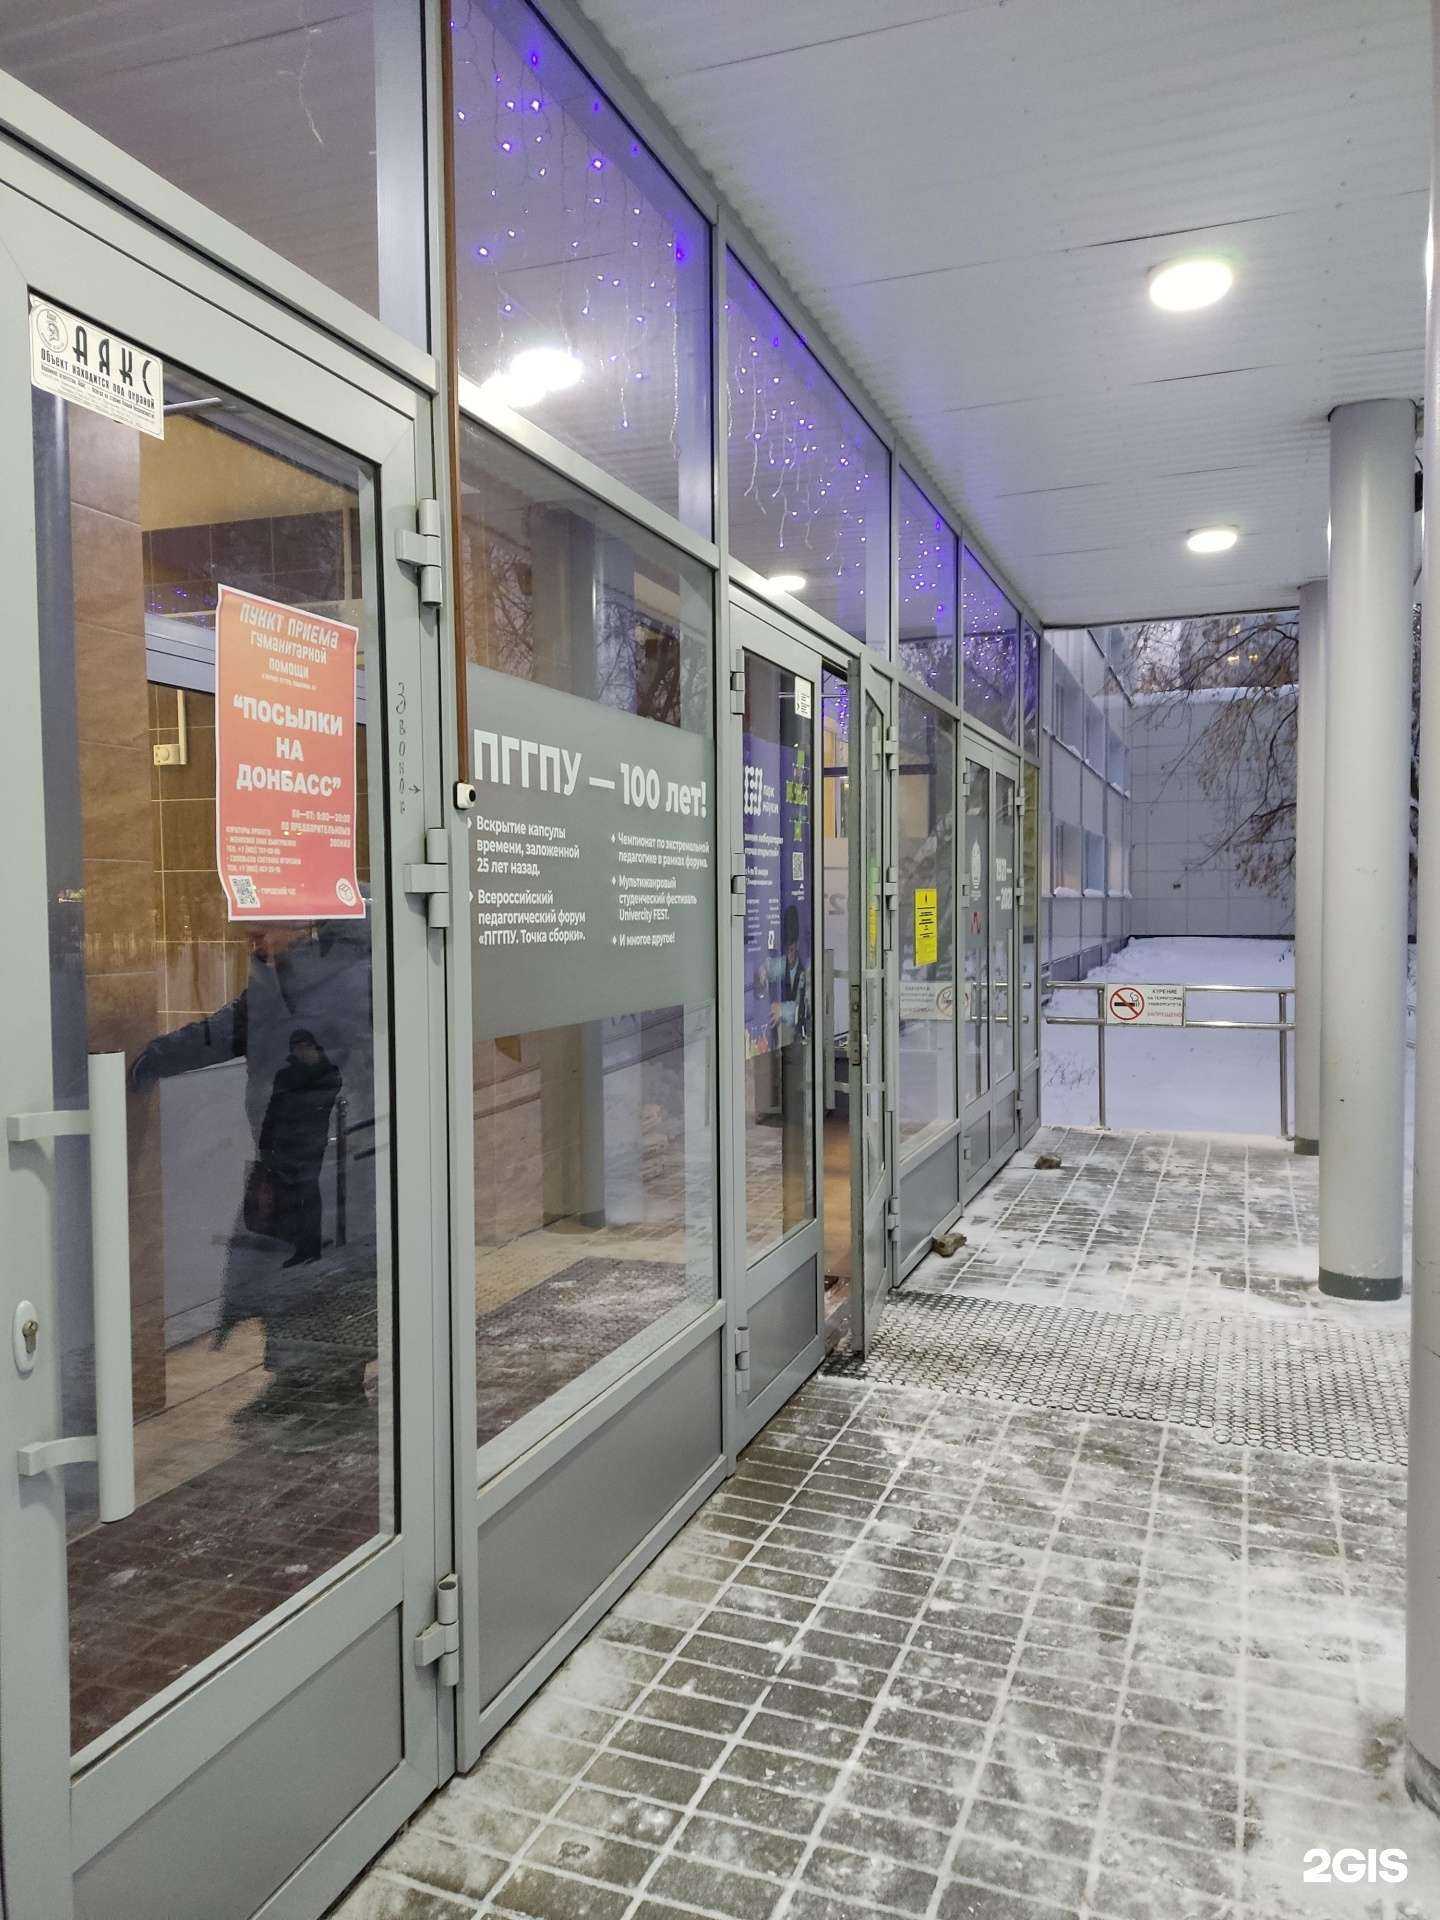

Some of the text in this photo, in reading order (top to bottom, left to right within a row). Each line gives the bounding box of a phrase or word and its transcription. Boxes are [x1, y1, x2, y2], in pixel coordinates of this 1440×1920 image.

[72, 325, 153, 396] АЯКС
[239, 602, 285, 633] ПУНКТ
[268, 656, 309, 680] ПОМОЩИ
[276, 736, 304, 762] НА
[474, 728, 707, 819] ПГГПУ — 100 лет!
[476, 815, 566, 841] Вскрытие капсулы
[476, 839, 580, 859] времени, заложенной
[618, 831, 656, 848] Чемпионат
[656, 839, 666, 849] по
[618, 851, 657, 864] педагогике
[476, 857, 541, 878] 25 лет назад.
[478, 889, 554, 908] Всероссийский
[618, 891, 666, 907] студенческий
[478, 908, 586, 927] педагогический форум
[619, 907, 653, 924] Univercity
[478, 927, 586, 946] «ПГГПУ. Точка сборки».
[619, 934, 626, 947] И
